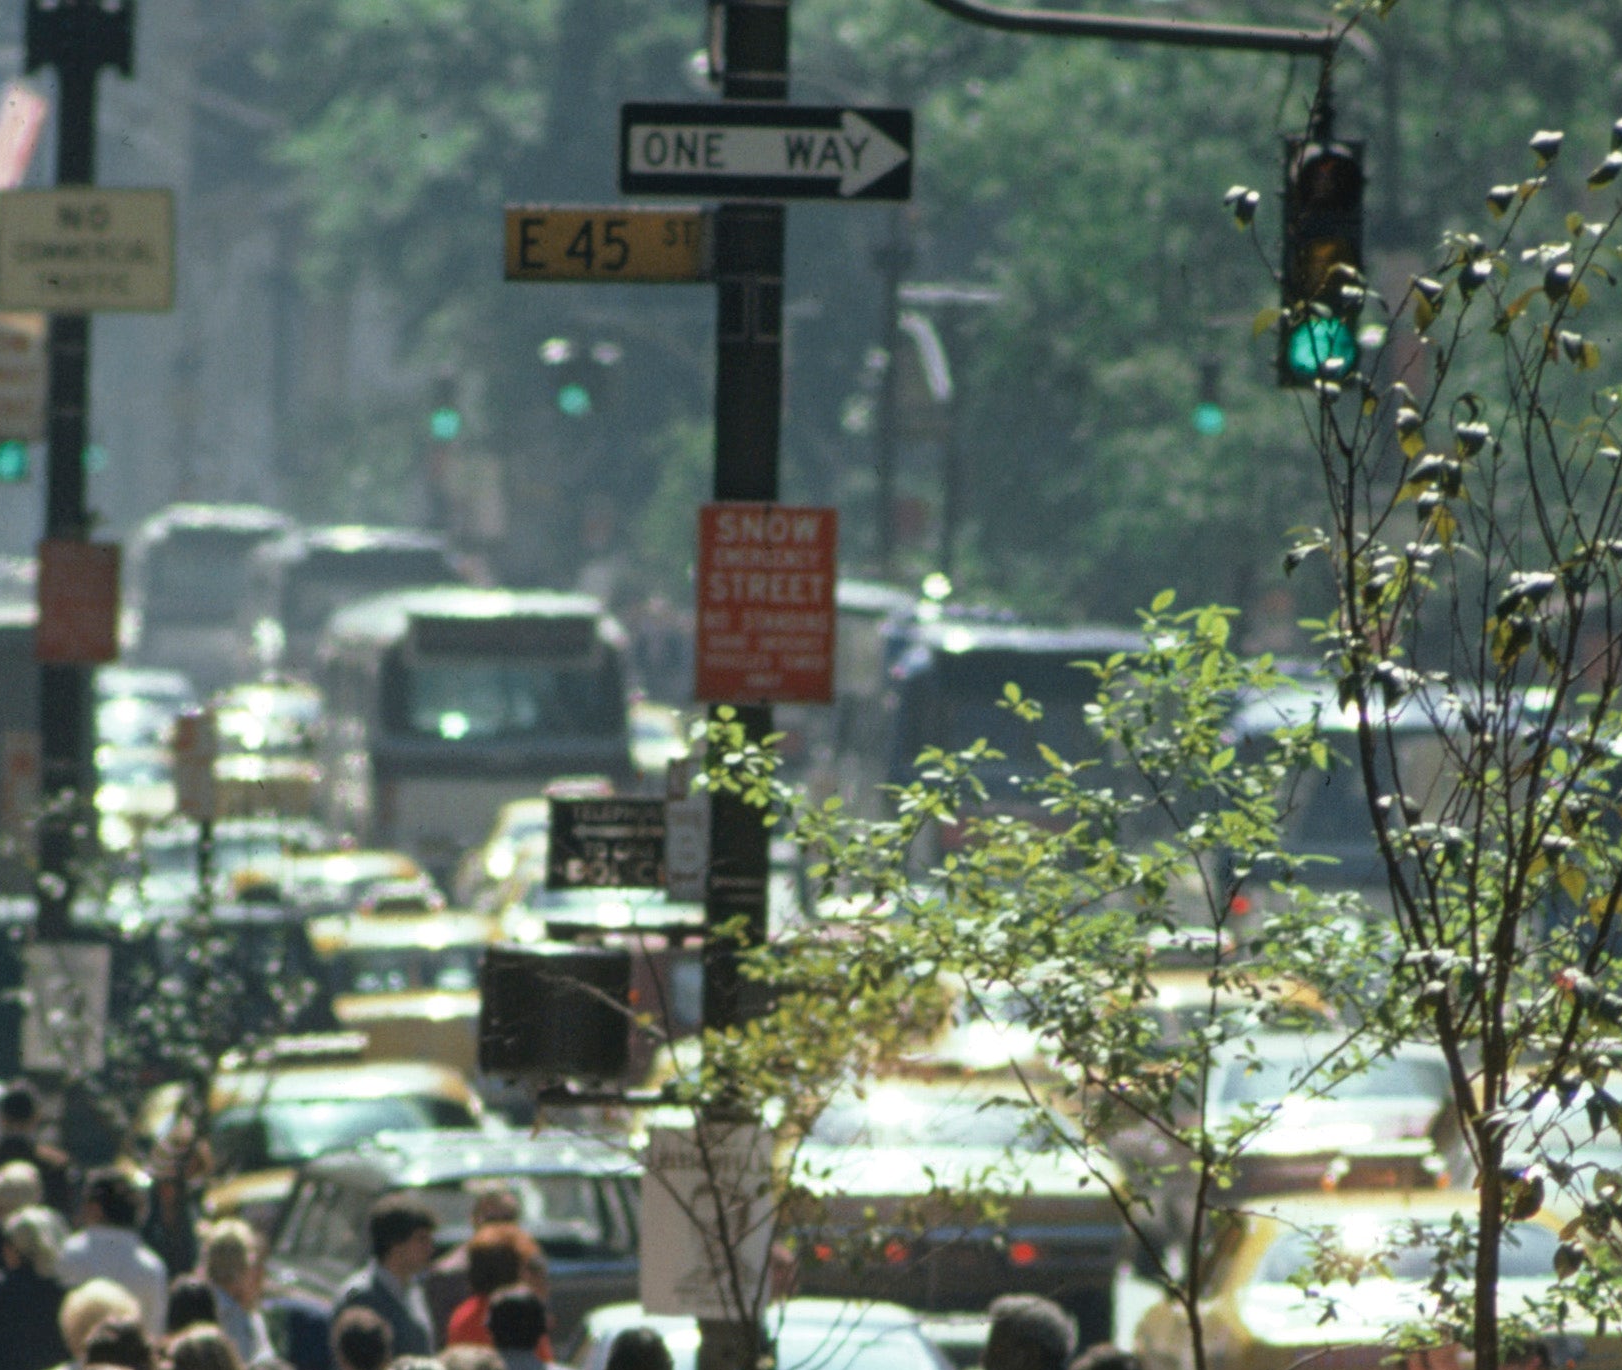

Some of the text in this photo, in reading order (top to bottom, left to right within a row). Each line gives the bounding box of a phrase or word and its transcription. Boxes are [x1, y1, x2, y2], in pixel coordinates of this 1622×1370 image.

[643, 131, 869, 171] ONE WAY
[57, 205, 108, 230] NO
[519, 217, 694, 271] E 45 ST
[715, 512, 820, 543] SNOW
[708, 572, 825, 603] STREET
